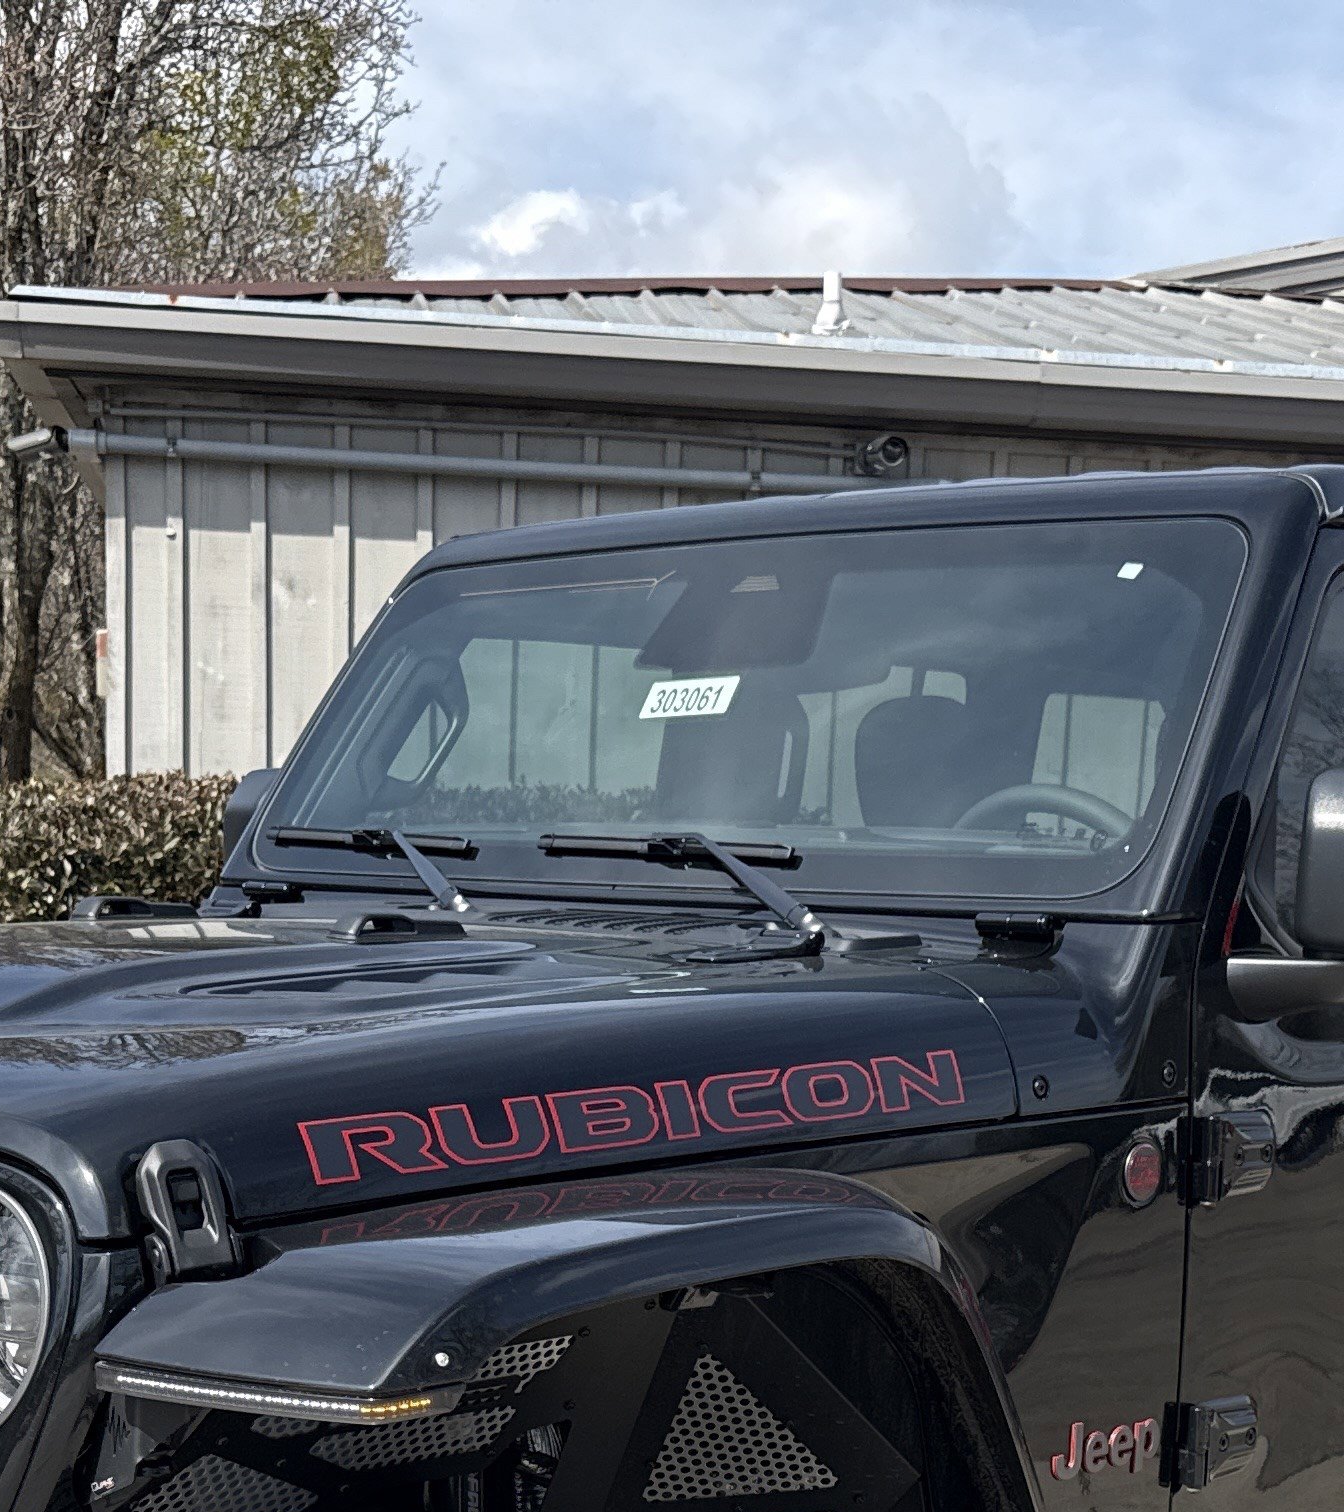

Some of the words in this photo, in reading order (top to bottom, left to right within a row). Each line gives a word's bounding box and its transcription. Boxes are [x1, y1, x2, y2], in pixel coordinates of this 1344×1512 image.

[650, 685, 725, 714] 303061
[297, 1049, 965, 1186] RUBICON
[1050, 1417, 1161, 1481] Jeep
